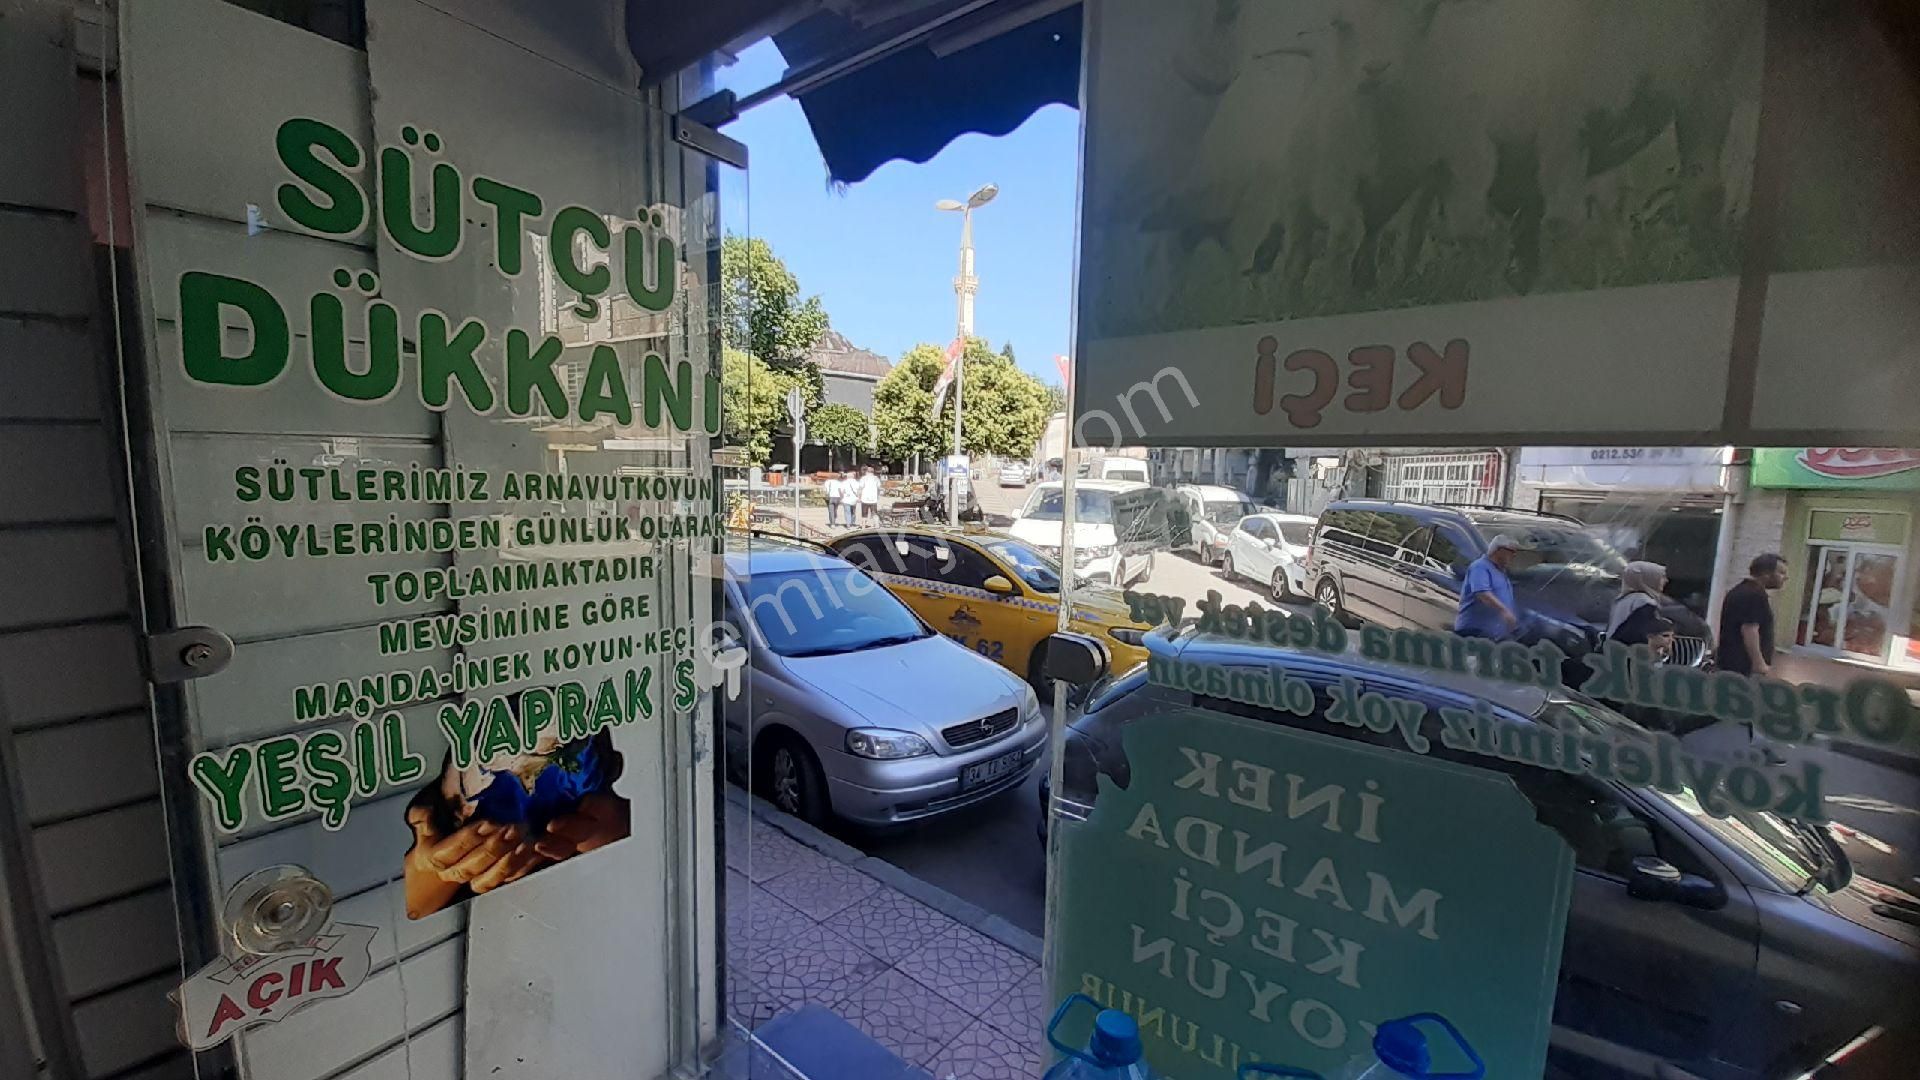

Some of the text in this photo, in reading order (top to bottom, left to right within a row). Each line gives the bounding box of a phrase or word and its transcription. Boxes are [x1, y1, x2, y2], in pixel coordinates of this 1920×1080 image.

[276, 117, 674, 320] SÜTÇÜ
[180, 267, 721, 433] DÜKKANI
[235, 458, 488, 501] SÜTLERİMİZ
[205, 511, 726, 561] KÖYLERİNDEN GÜNLÜK OLARAK
[368, 557, 655, 605] TOPLANMAKTADIR
[379, 592, 651, 655] MEVSİMİNE GÖRE
[191, 696, 425, 829] YEŞİL
[439, 664, 654, 769] YAPRAK
[206, 956, 346, 1038] AÇIK
